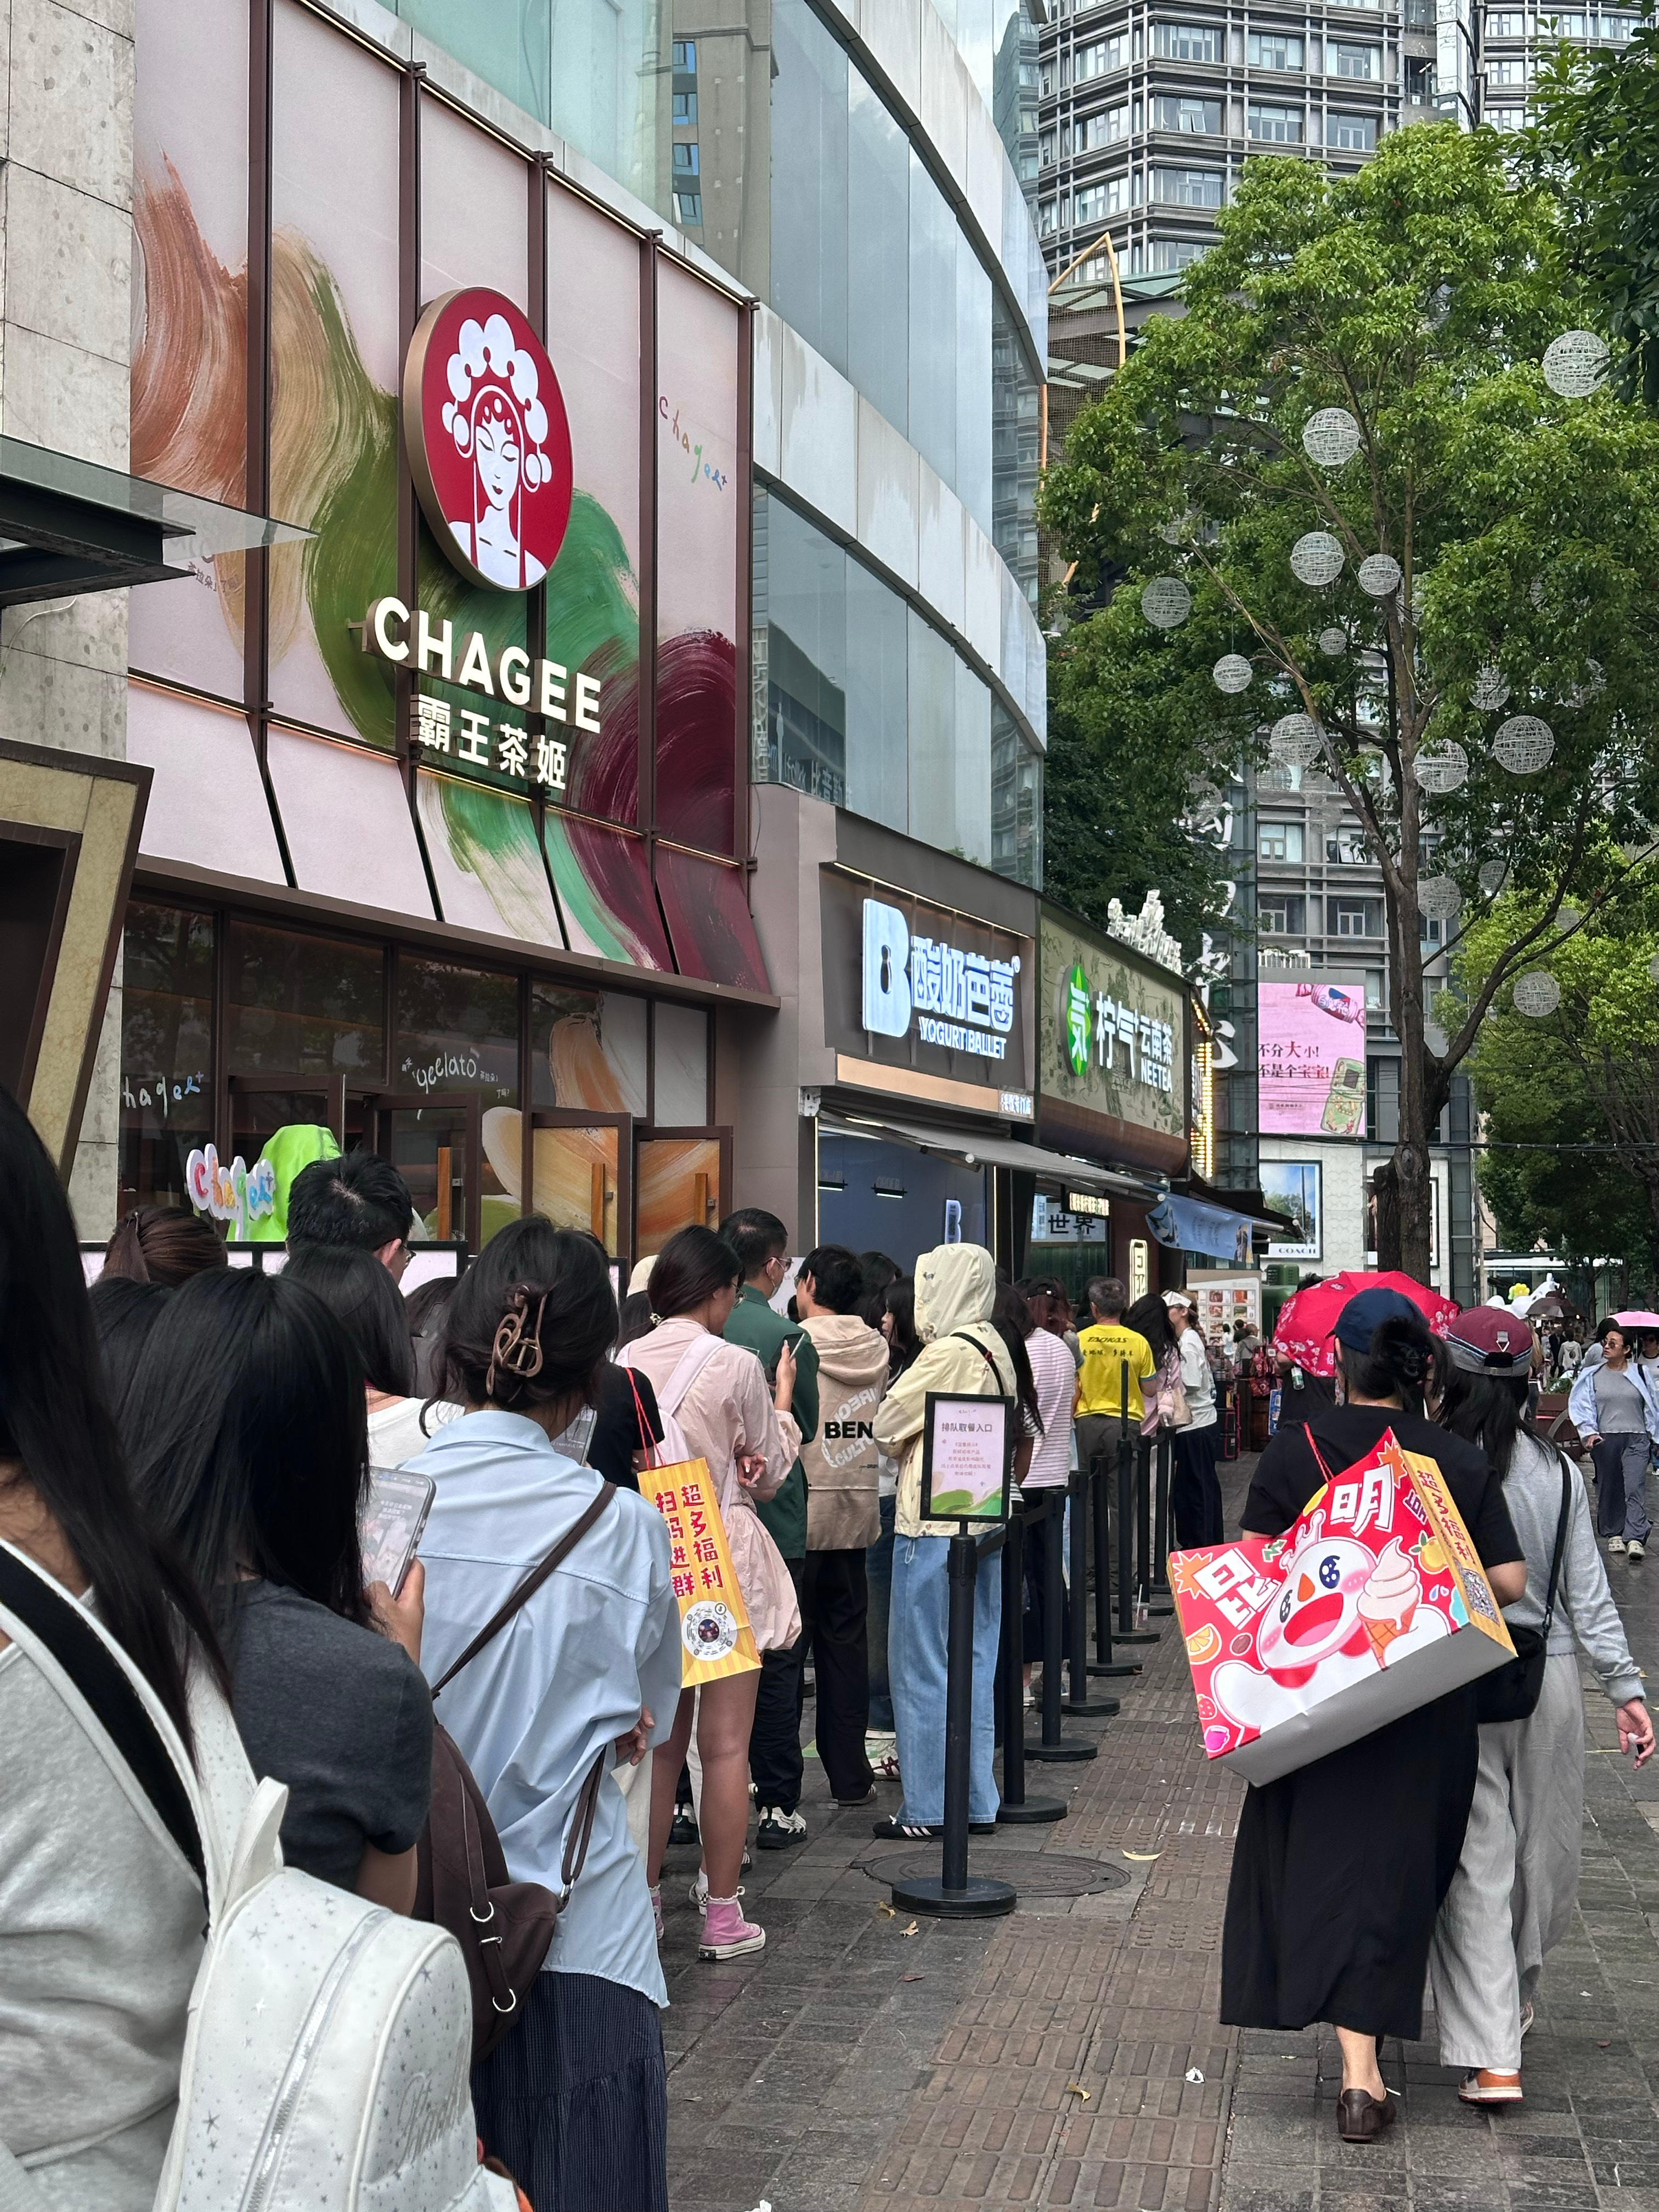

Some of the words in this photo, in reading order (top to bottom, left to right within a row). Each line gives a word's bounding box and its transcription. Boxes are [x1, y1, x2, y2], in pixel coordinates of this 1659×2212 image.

[374, 596, 601, 733] CHAGEE
[418, 693, 567, 790] 霸王茶姬
[863, 898, 911, 1038] B
[911, 935, 1014, 1032] 酸奶芭蕾
[918, 1016, 966, 1050] YOGURT
[966, 1030, 1007, 1060] BALLET
[1140, 1015, 1172, 1066] 云南茶
[1141, 1057, 1172, 1093] NEETEA
[1048, 1214, 1096, 1235] 世界
[941, 1423, 992, 1433] 排队取餐入口
[654, 1490, 695, 1598] 扫码进群
[681, 1483, 724, 1589] 超多福利
